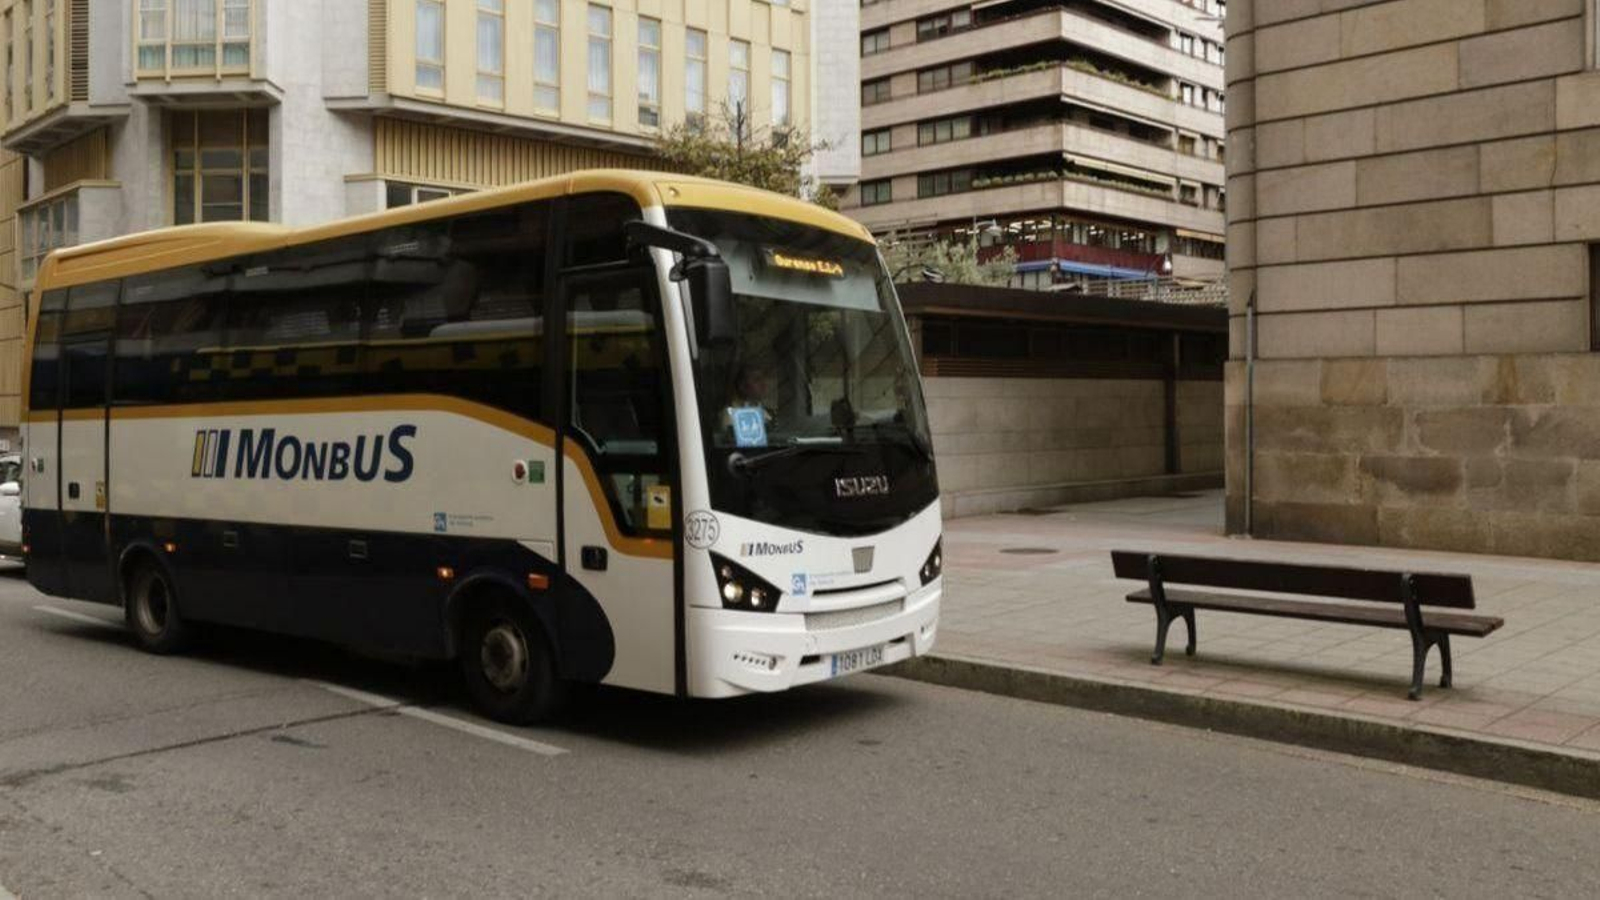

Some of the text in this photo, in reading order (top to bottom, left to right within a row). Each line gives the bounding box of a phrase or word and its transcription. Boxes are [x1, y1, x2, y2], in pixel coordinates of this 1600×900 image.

[234, 424, 417, 483] MONBUS
[834, 475, 889, 497] ISUZU
[684, 518, 717, 541] 3275
[755, 540, 804, 556] MONBUS
